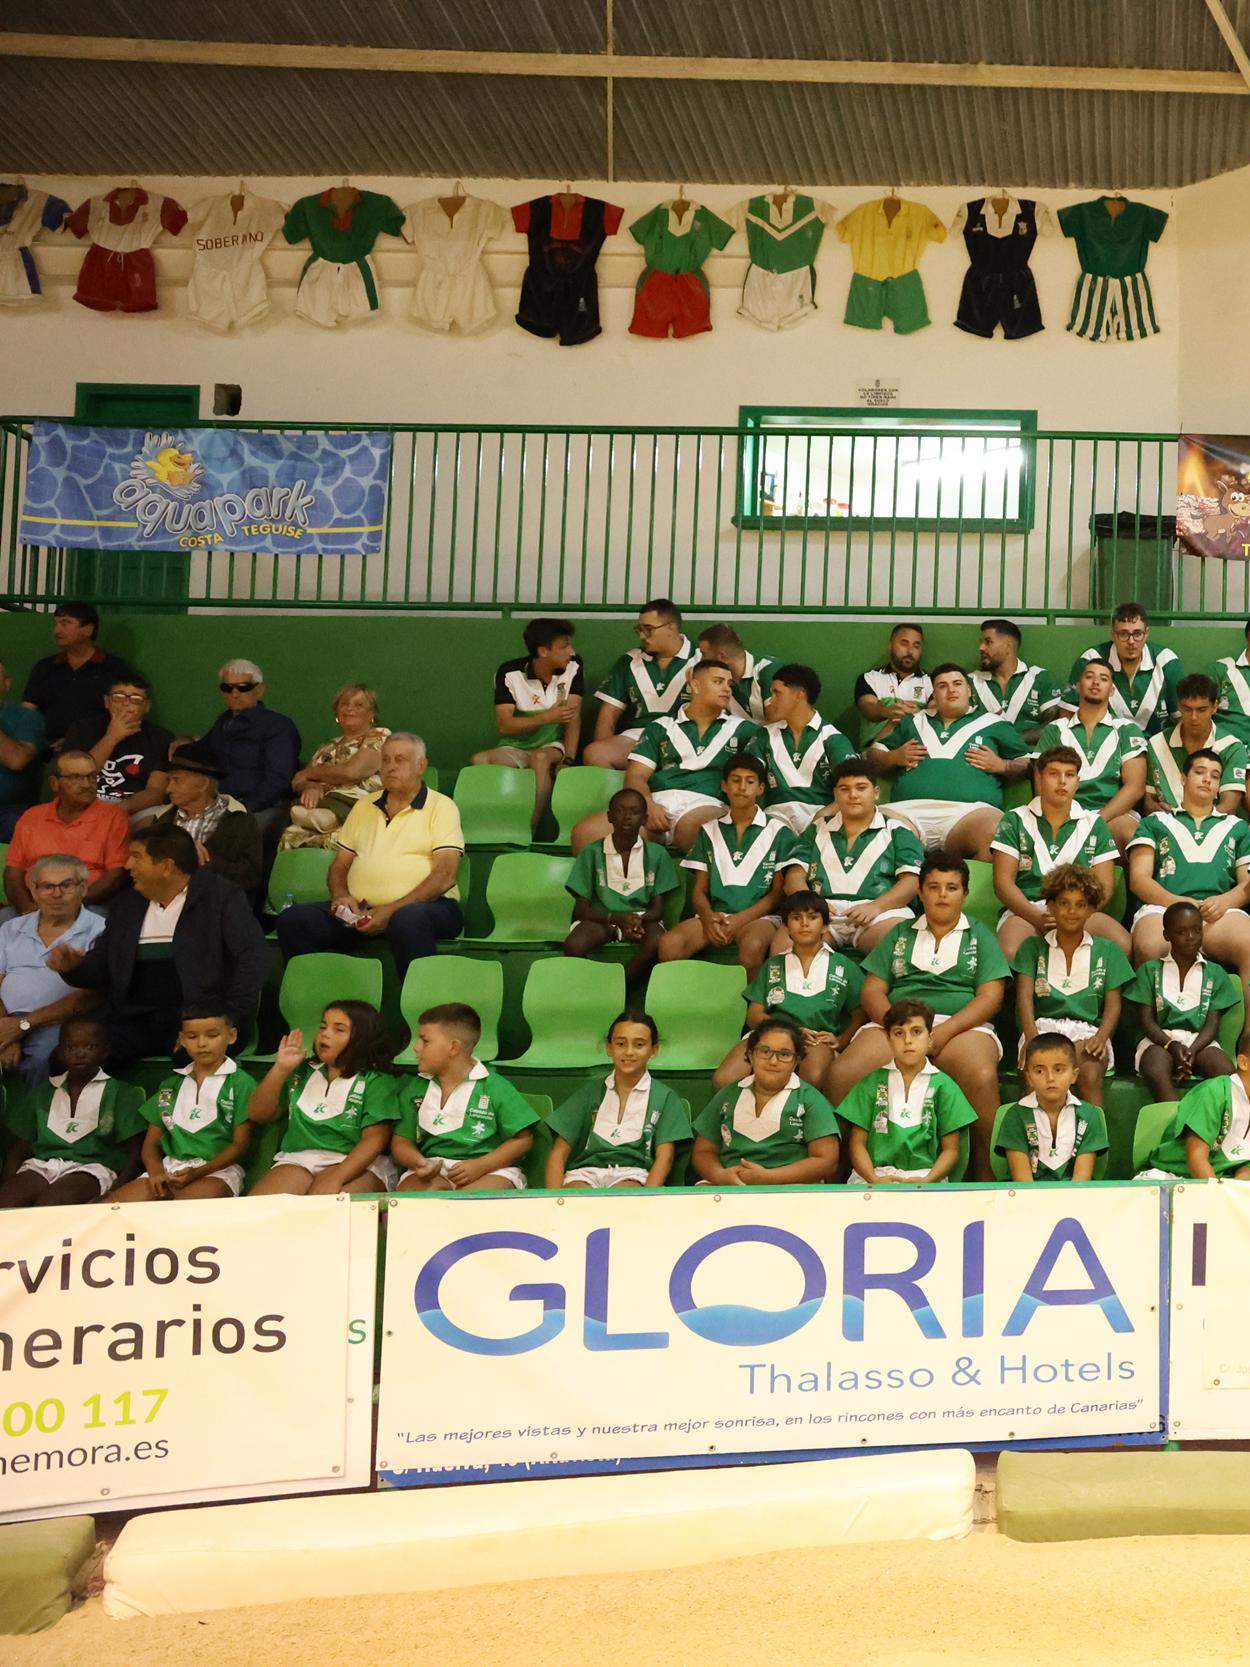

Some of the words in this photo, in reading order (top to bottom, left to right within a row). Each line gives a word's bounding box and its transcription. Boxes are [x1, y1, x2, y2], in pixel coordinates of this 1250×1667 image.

[196, 230, 264, 251] SOBERANO
[113, 479, 315, 538] aquapark
[179, 533, 224, 548] COSTA
[242, 523, 304, 540] TEGUISE
[414, 1216, 1136, 1357] GLORIA
[738, 1360, 935, 1395] Thalasso
[951, 1355, 982, 1386] &
[999, 1352, 1136, 1385] Hotels
[82, 1388, 169, 1429] 117
[443, 1429, 512, 1444] mejores
[517, 1425, 572, 1438] vistas
[576, 1425, 587, 1438] y
[591, 1421, 658, 1435] nuestra
[663, 1419, 710, 1433] mejor
[714, 1415, 779, 1429] sonrisa,
[785, 1415, 803, 1426] en
[808, 1413, 833, 1425] los
[838, 1411, 904, 1423] rincones
[909, 1410, 936, 1421] con
[942, 1406, 975, 1419] más
[979, 1404, 1042, 1417] encanto
[1047, 1403, 1066, 1415] de
[0, 1439, 169, 1475] emora.es
